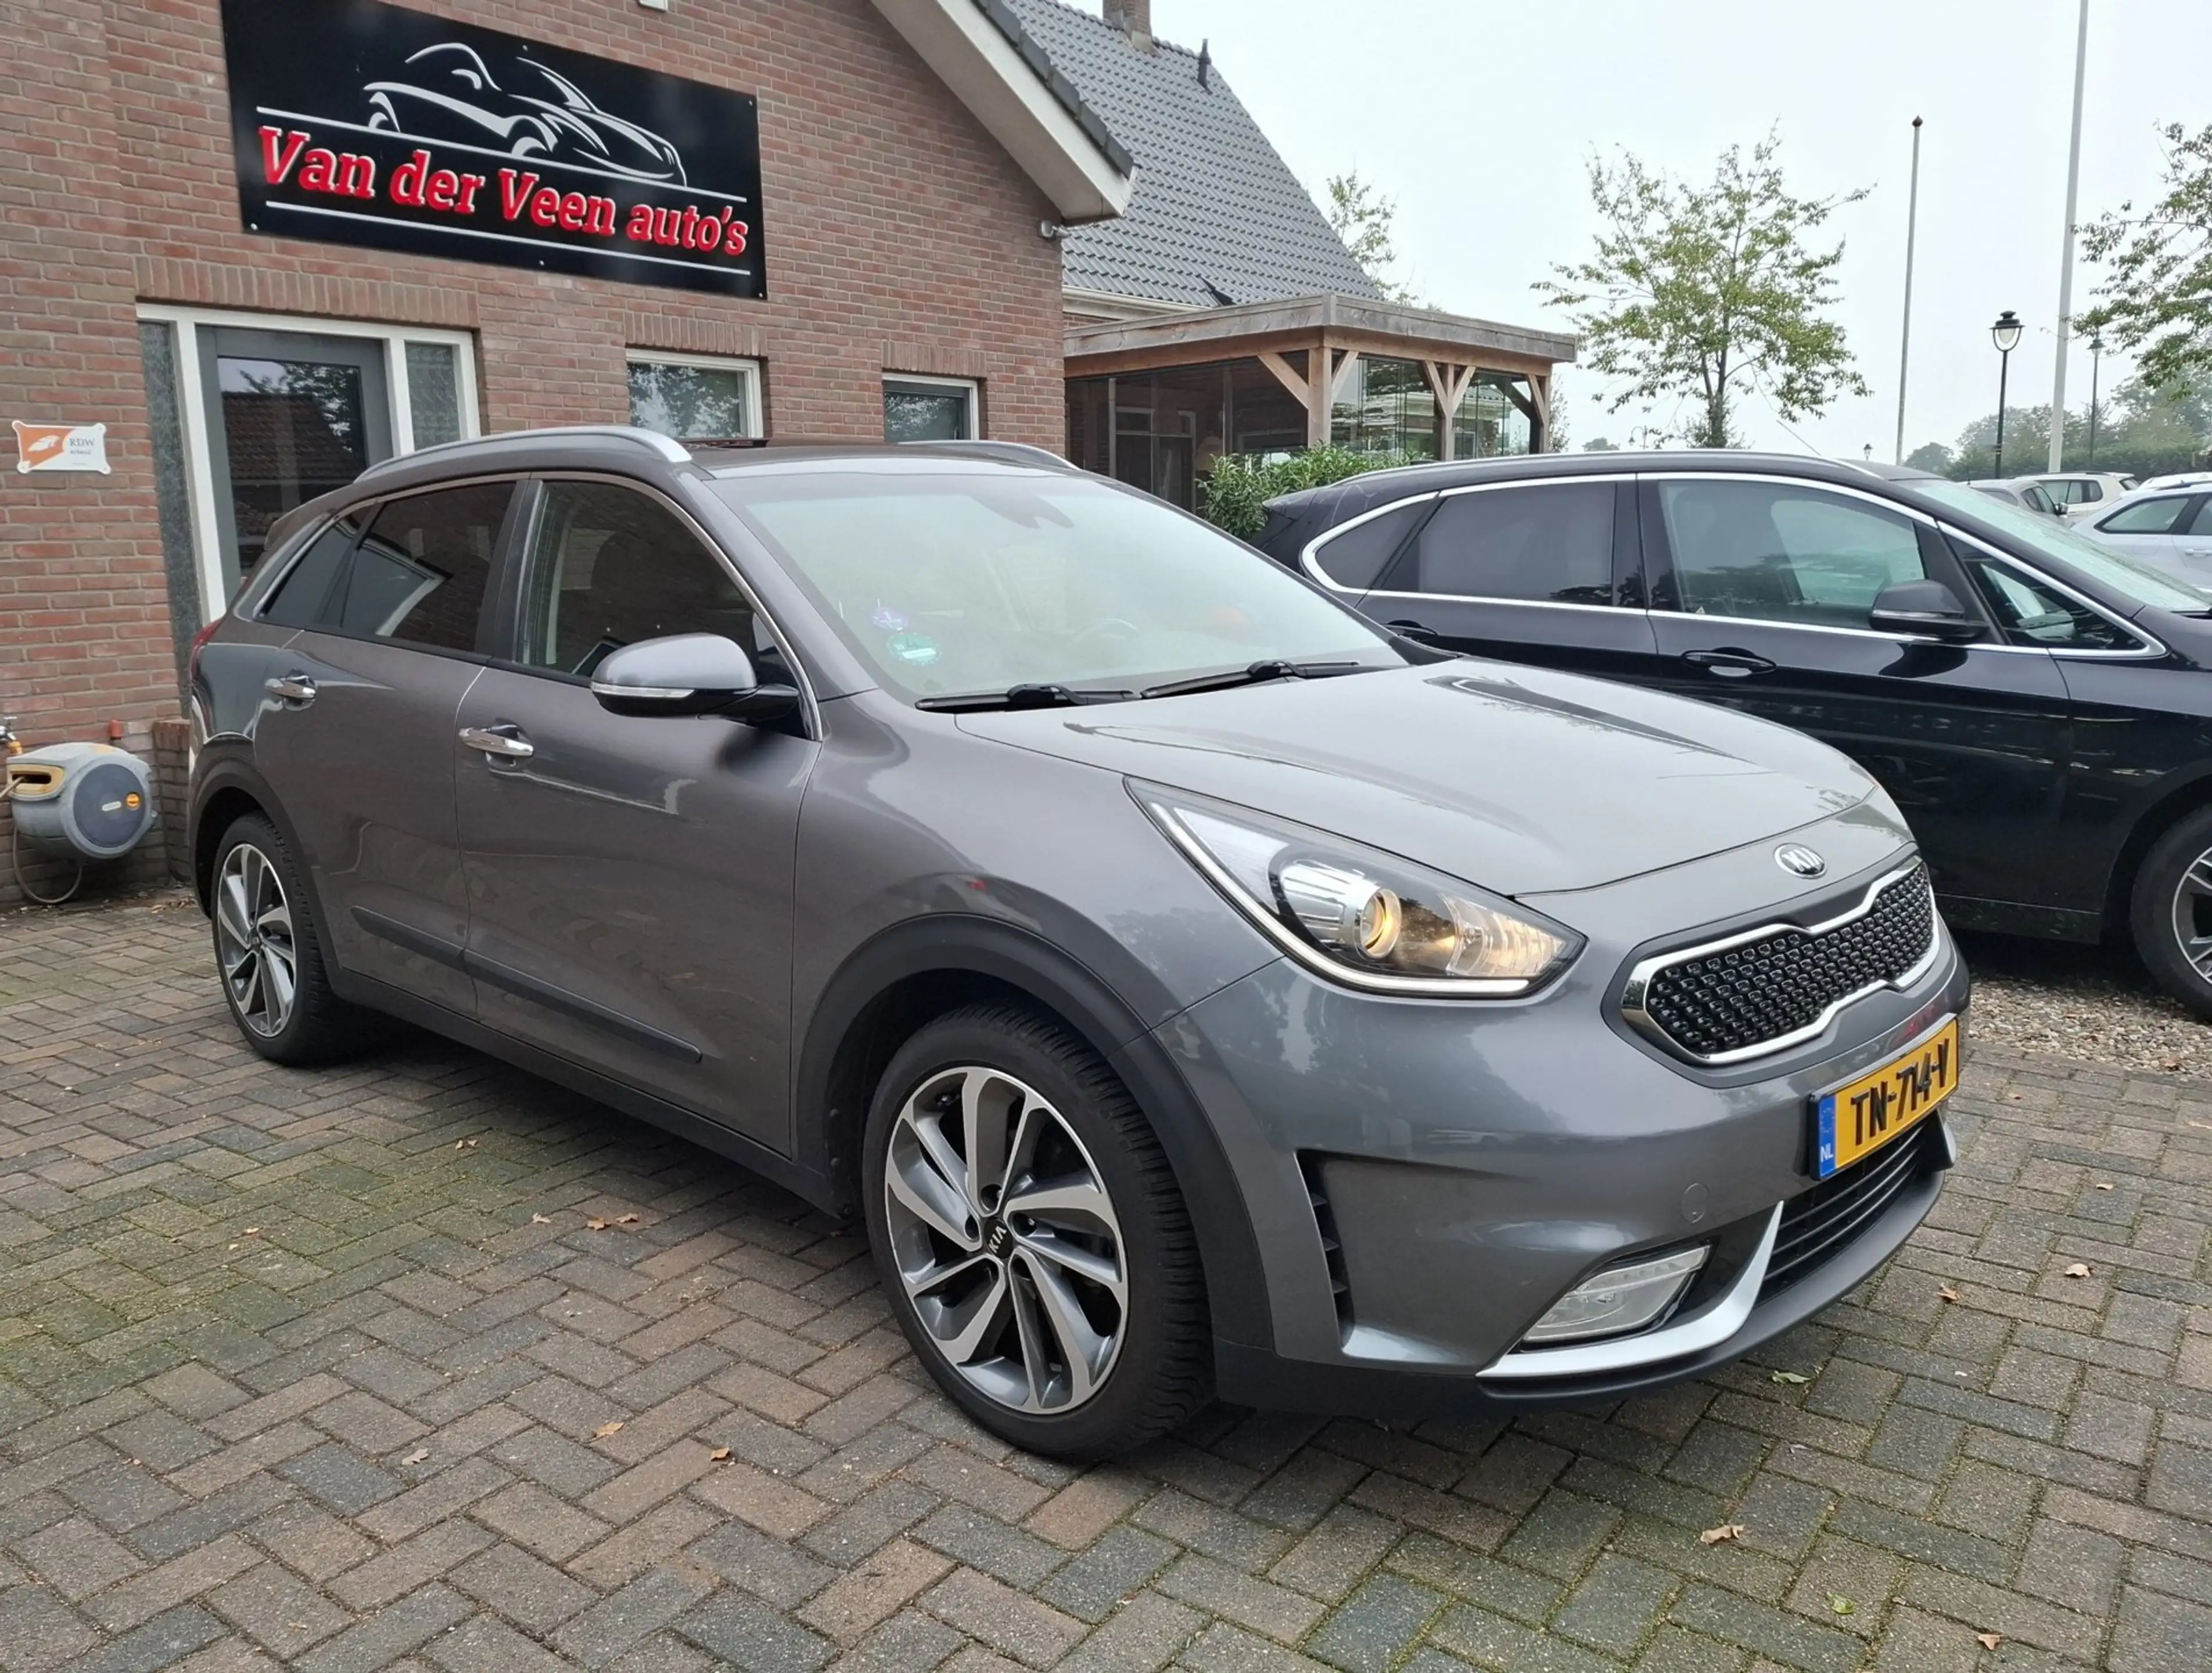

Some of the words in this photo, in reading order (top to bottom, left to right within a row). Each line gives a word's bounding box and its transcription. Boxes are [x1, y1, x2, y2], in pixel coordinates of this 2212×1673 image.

[258, 125, 376, 199] Van
[390, 149, 486, 214] der
[498, 168, 616, 236] Veen
[626, 206, 749, 256] auto's
[69, 438, 94, 447] RDW
[1851, 1038, 1949, 1146] TN-714-V
[1820, 1142, 1834, 1162] NL
[989, 1225, 1007, 1254] KIA
